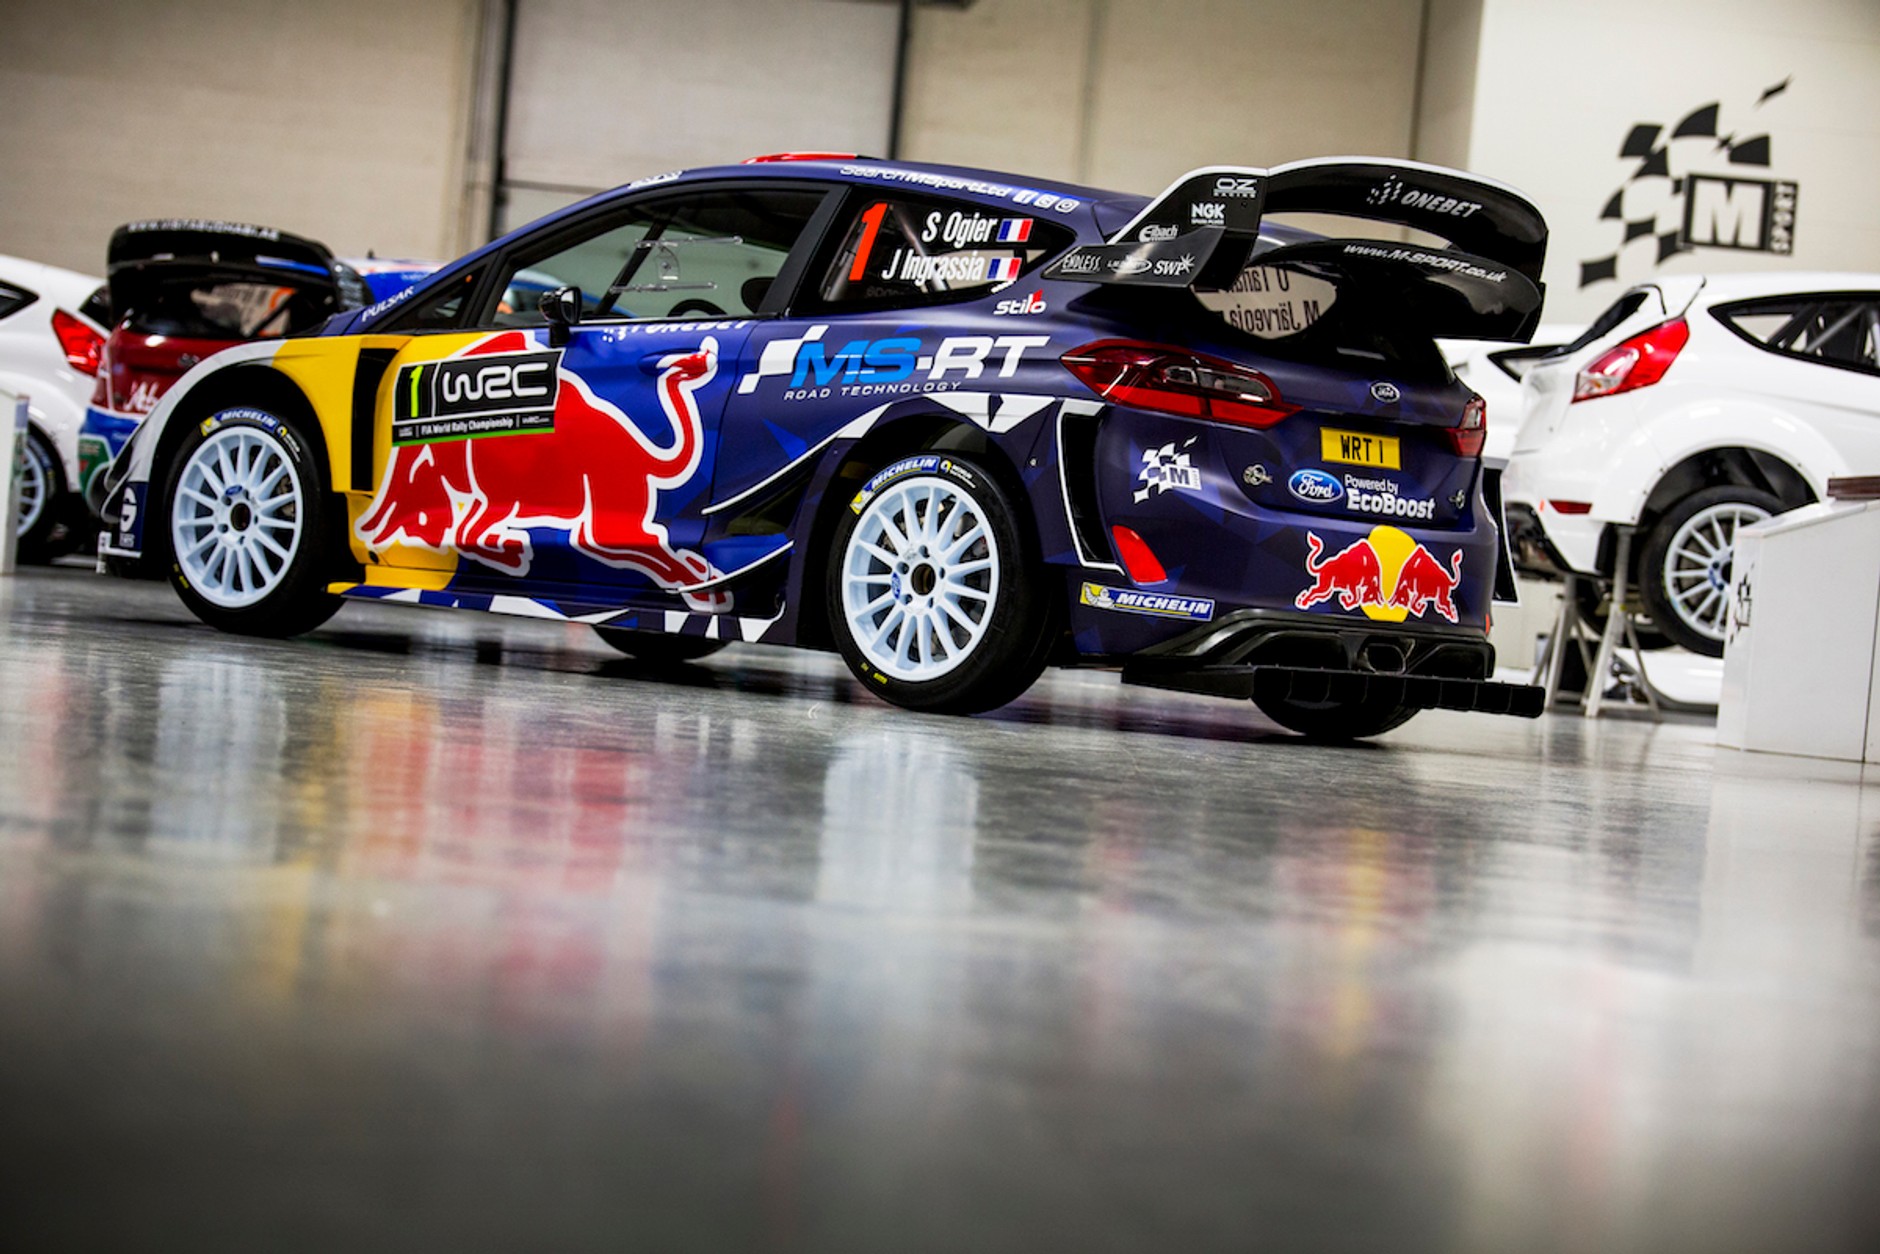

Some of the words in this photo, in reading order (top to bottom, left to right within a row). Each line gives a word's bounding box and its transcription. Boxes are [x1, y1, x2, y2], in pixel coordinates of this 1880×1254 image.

[1215, 178, 1258, 191] OZ
[1191, 203, 1226, 219] NGK
[1401, 189, 1483, 218] ONEBET
[1691, 179, 1764, 248] M
[848, 203, 888, 281] 1
[921, 212, 943, 244] S
[943, 212, 998, 249] Ogier
[881, 249, 902, 280] J
[901, 250, 985, 287] Ingrassia
[1061, 255, 1101, 272] ENDLESS
[993, 289, 1047, 316] stilo
[409, 365, 424, 418] 1
[442, 362, 549, 403] WRC
[783, 387, 832, 401] ROAD
[840, 381, 962, 397] TECHNOLOGY
[219, 409, 275, 428] MICHELIN
[434, 422, 450, 434] World
[452, 420, 468, 433] Rally
[469, 417, 514, 431] Championship
[1340, 434, 1373, 462] WRT
[871, 458, 937, 489] MICHELIN
[1168, 467, 1190, 486] M
[1297, 473, 1335, 499] Ford
[1344, 474, 1387, 492] Powered
[1386, 479, 1399, 495] by
[1346, 488, 1436, 520] EcoBoost
[1116, 592, 1211, 615] MICHELIN
